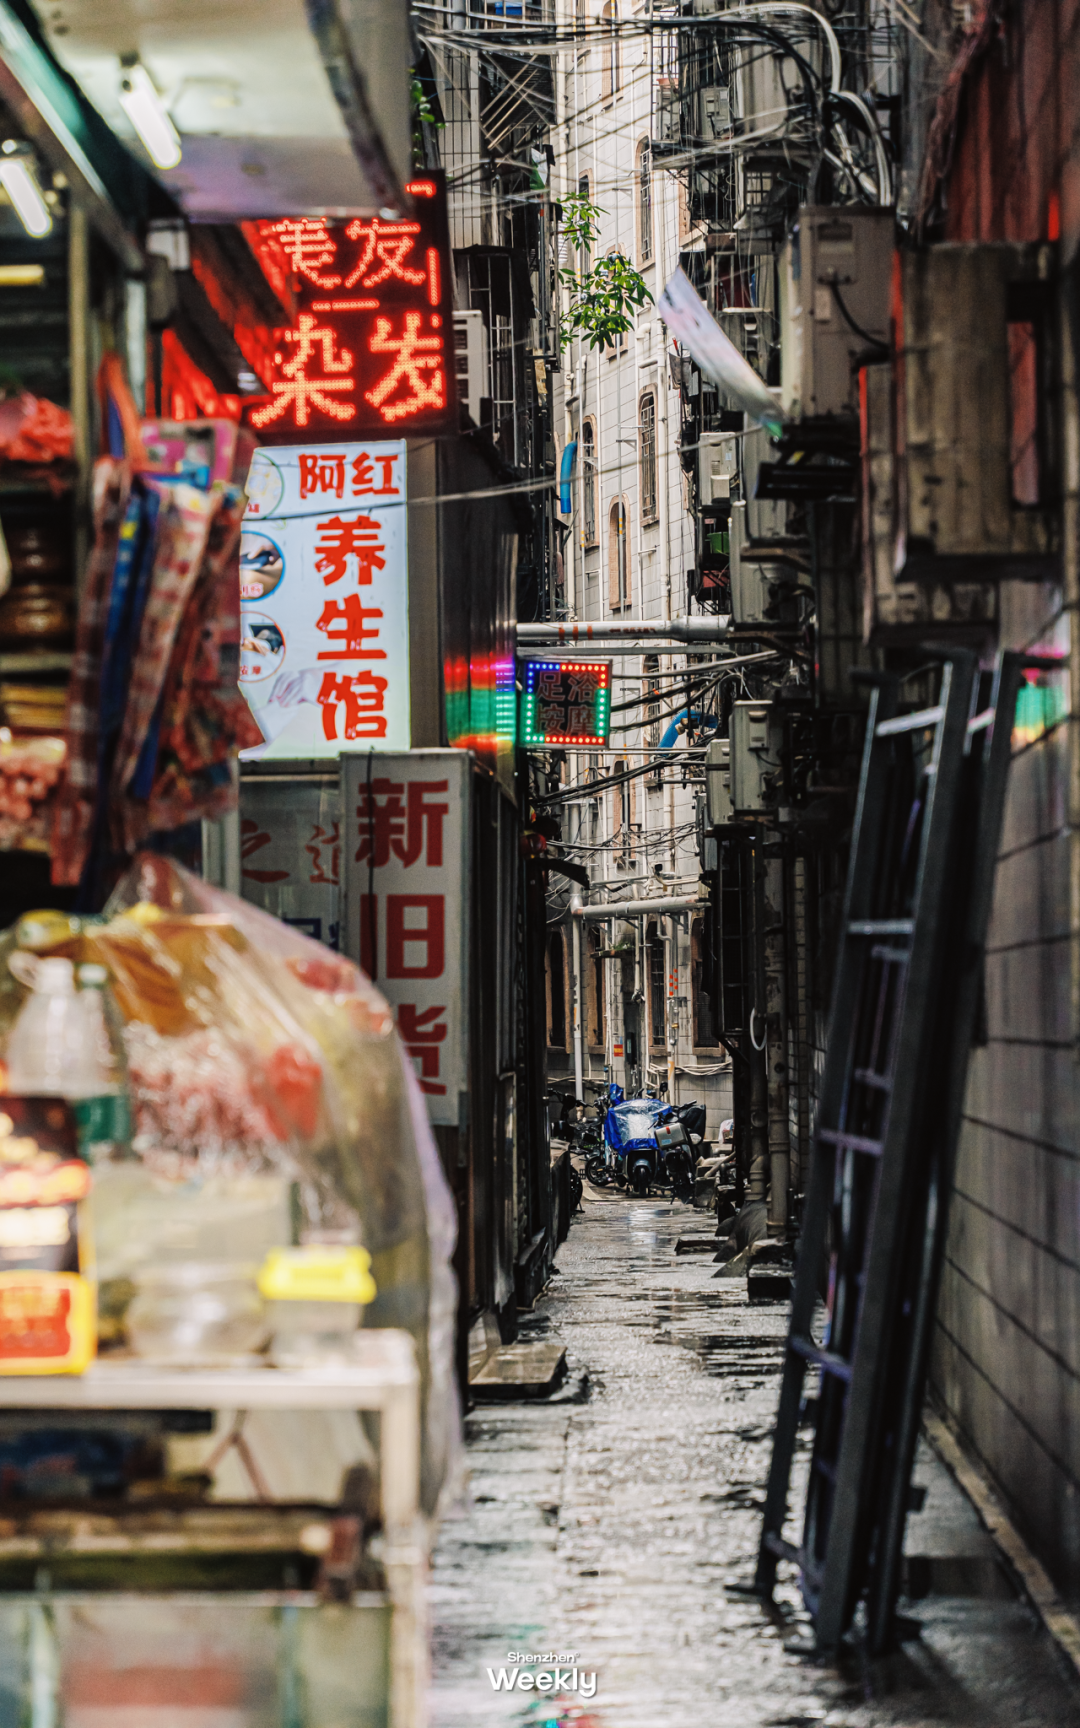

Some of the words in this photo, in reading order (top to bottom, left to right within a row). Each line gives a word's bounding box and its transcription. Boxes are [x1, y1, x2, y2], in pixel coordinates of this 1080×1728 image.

[251, 311, 443, 427] 染发
[298, 452, 401, 499] 阿红
[314, 515, 389, 741] 养生馆
[536, 670, 599, 702] 足浴
[536, 703, 598, 736] 按摩
